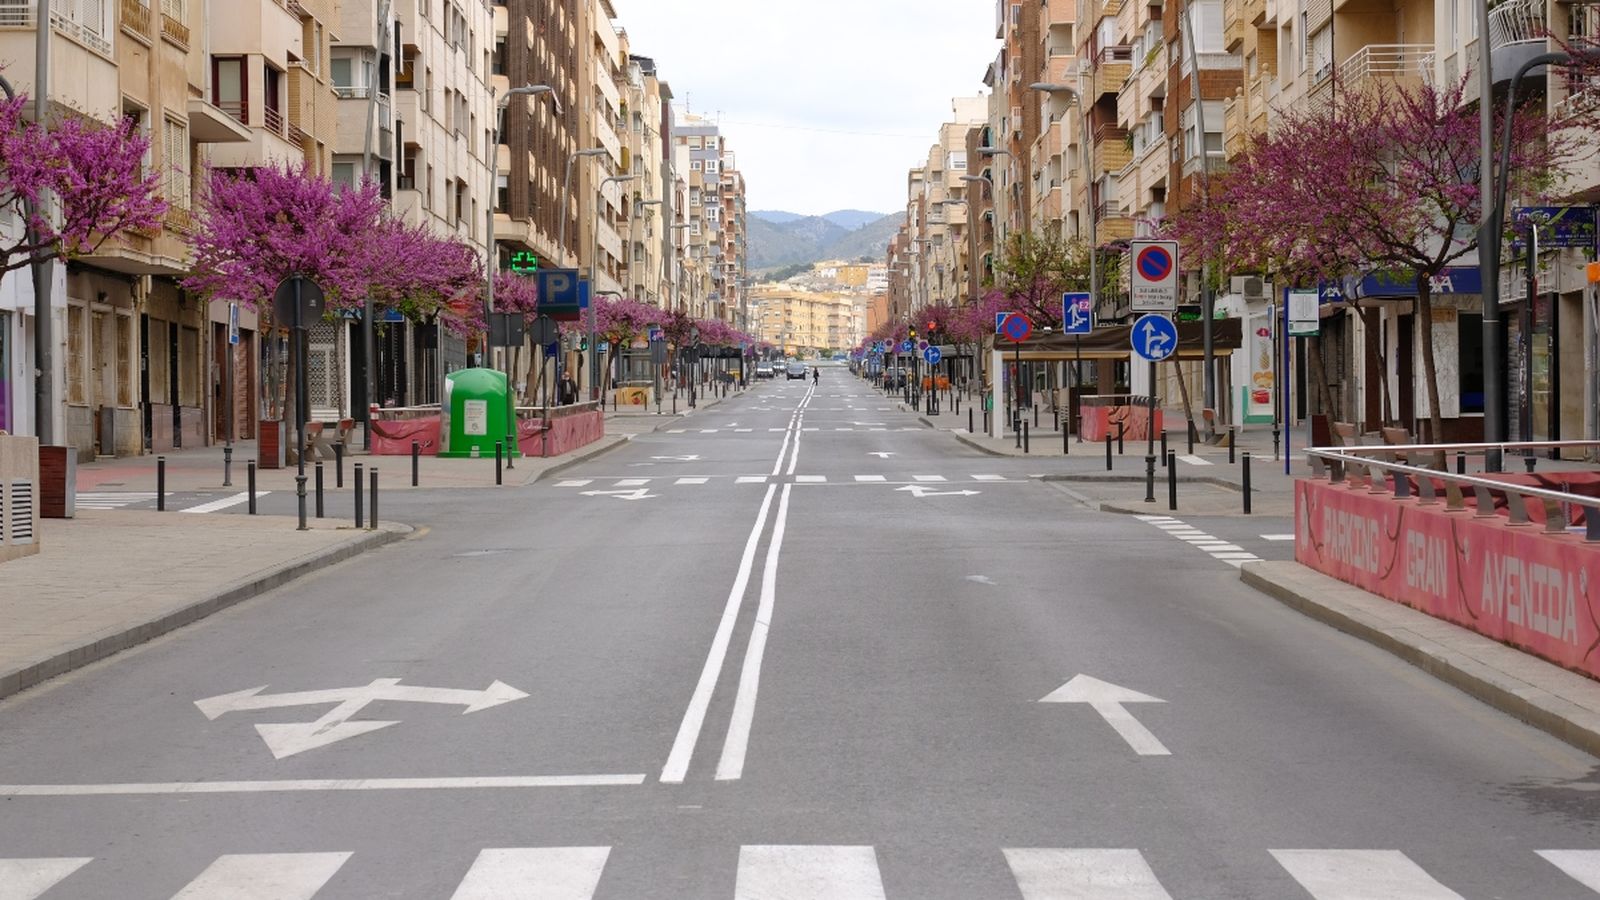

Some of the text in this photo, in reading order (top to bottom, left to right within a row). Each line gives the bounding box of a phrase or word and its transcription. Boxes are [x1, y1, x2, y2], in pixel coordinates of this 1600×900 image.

[546, 273, 570, 303] P
[1324, 506, 1578, 646] PARKING GRAN AVENIDA
